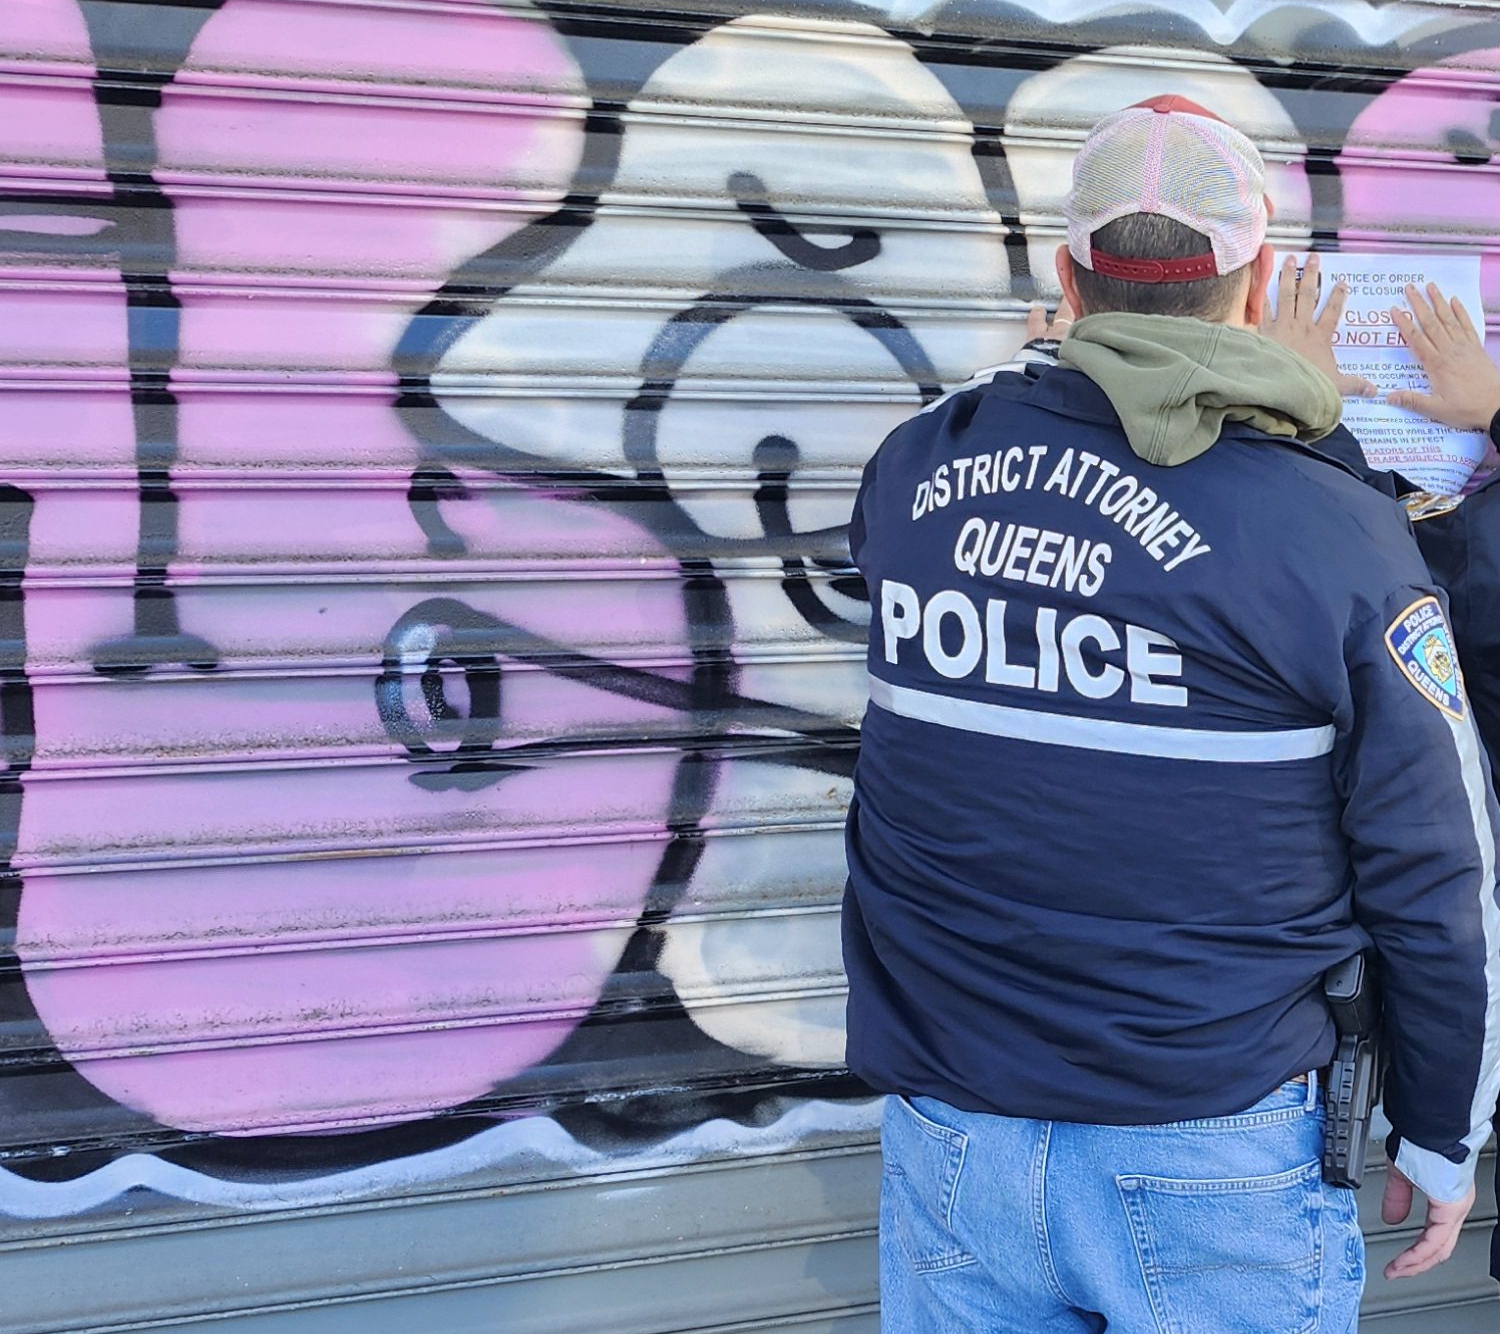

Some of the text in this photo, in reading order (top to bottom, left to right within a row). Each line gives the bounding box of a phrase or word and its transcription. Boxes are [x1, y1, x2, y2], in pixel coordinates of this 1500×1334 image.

[1331, 273, 1425, 283] NOTICE OF ORDER
[1346, 286, 1406, 296] OF CLOSUR
[1345, 310, 1414, 324] CLOSD
[1346, 331, 1382, 345] NOT
[1360, 364, 1380, 372] SALE
[1382, 363, 1393, 372] OF
[1351, 427, 1404, 436] PROHIBITED
[1405, 427, 1436, 436] WHILE
[1411, 436, 1446, 444] EFFECT
[1402, 454, 1444, 463] SUBJECT
[1446, 454, 1458, 463] TO
[912, 445, 1211, 572] DISTRICT ATTORNEY
[954, 517, 1112, 598] QUEENS
[1403, 604, 1435, 633] POLICE
[881, 579, 1188, 707] POLICE
[1407, 660, 1450, 707] QUEENS
